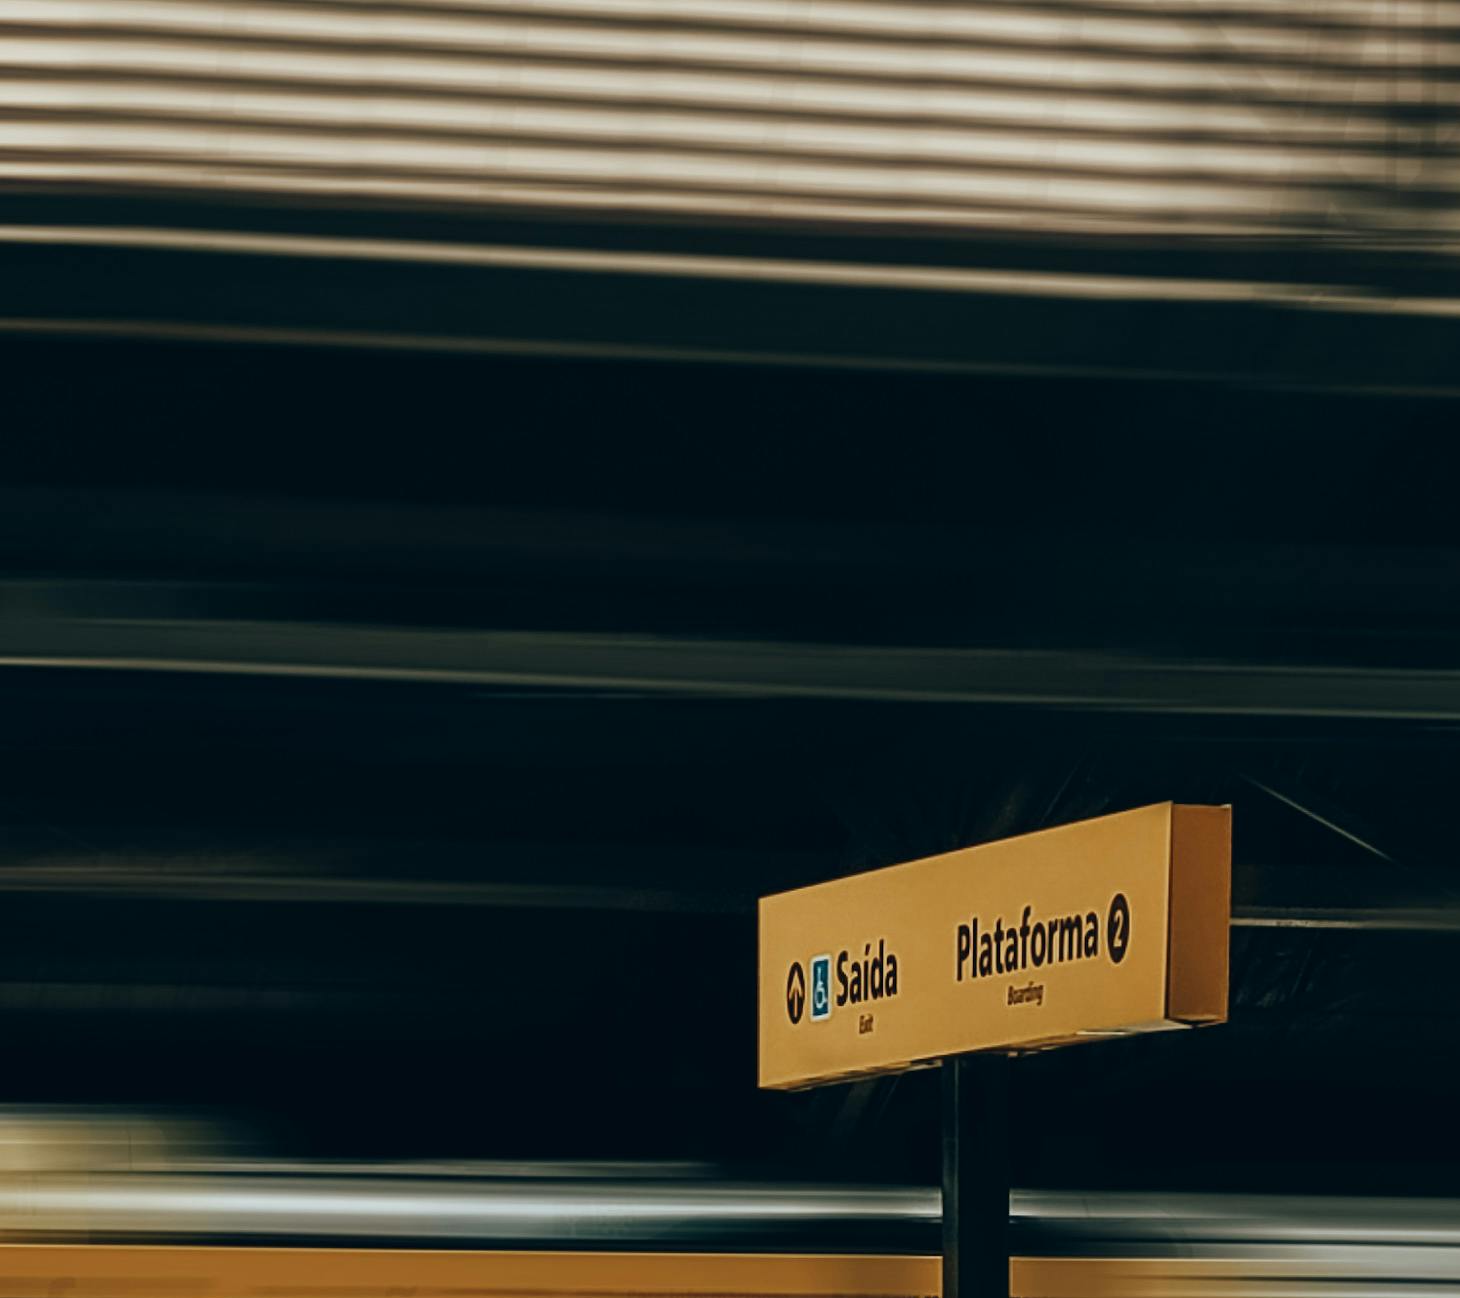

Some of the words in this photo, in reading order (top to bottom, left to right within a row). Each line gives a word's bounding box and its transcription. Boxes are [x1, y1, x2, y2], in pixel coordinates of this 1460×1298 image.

[957, 905, 1099, 981] Plataforma
[835, 938, 898, 1007] Saída
[1007, 981, 1045, 1006] Boarding
[859, 1014, 874, 1034] Exit
